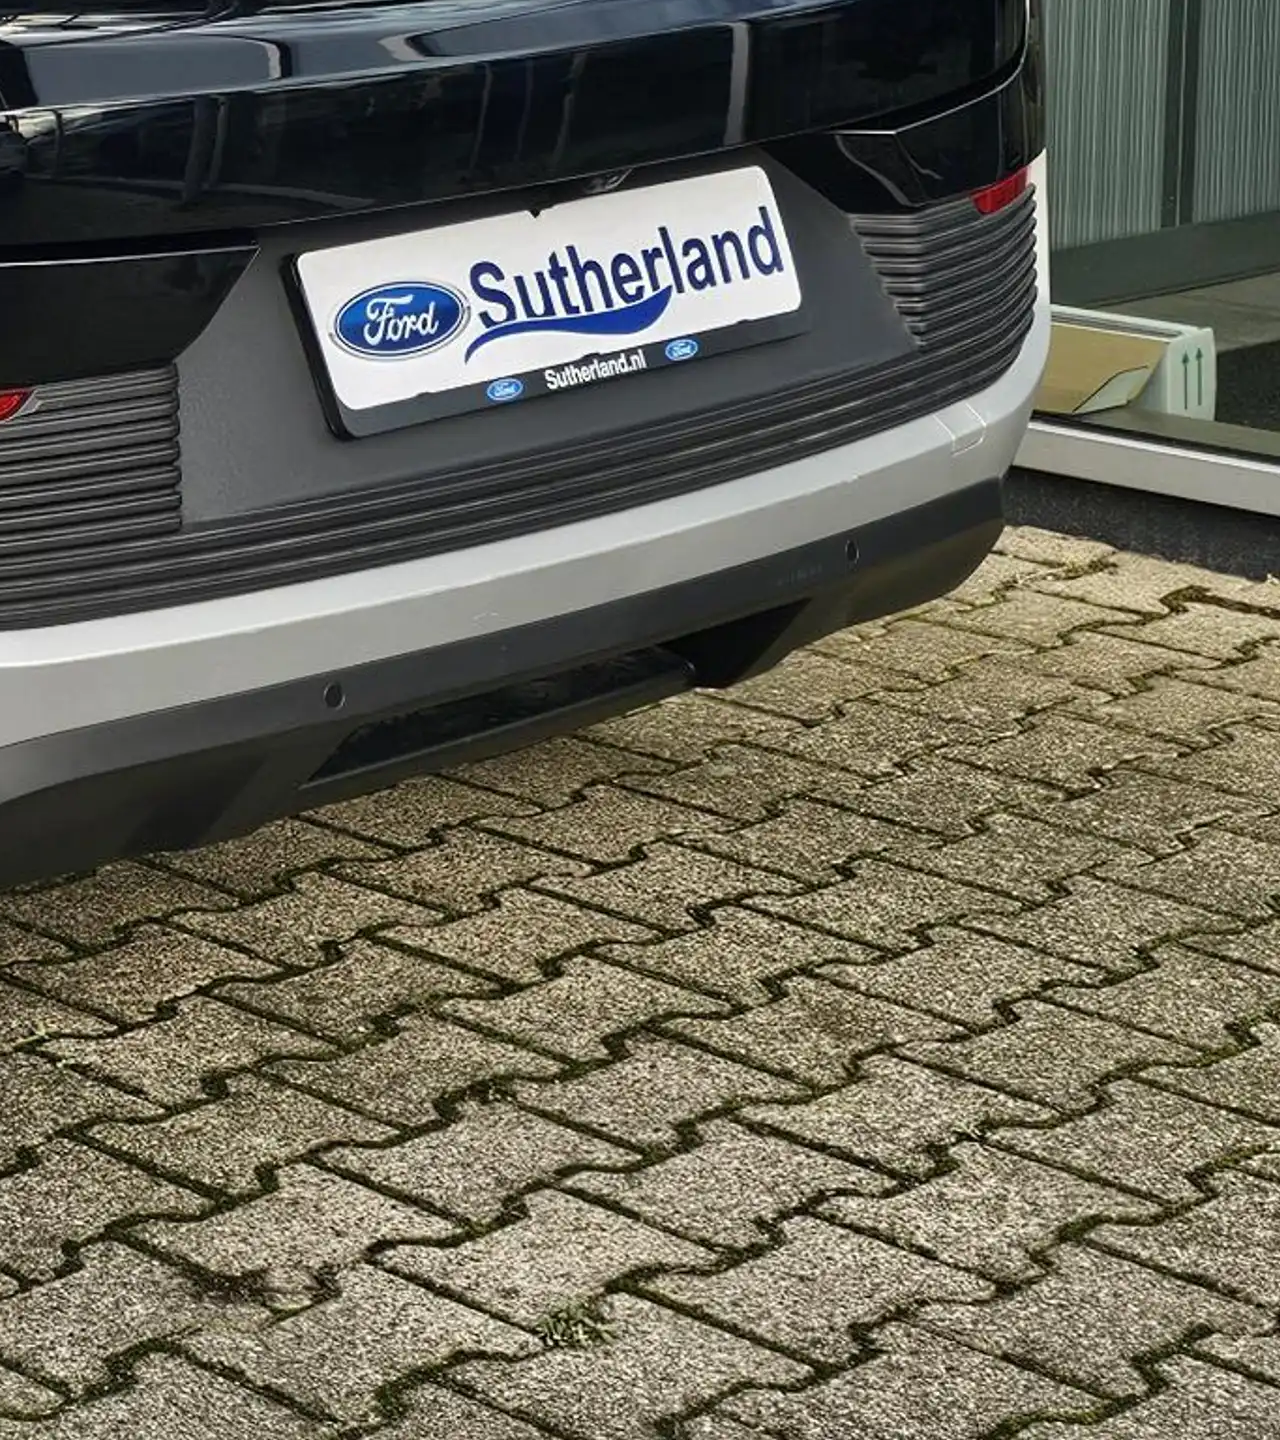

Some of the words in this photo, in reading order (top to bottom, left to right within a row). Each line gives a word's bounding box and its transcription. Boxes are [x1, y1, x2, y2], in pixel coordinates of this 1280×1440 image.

[469, 206, 784, 329] Sutherland
[363, 294, 439, 346] Ford
[545, 348, 647, 390] Sutherland.nl
